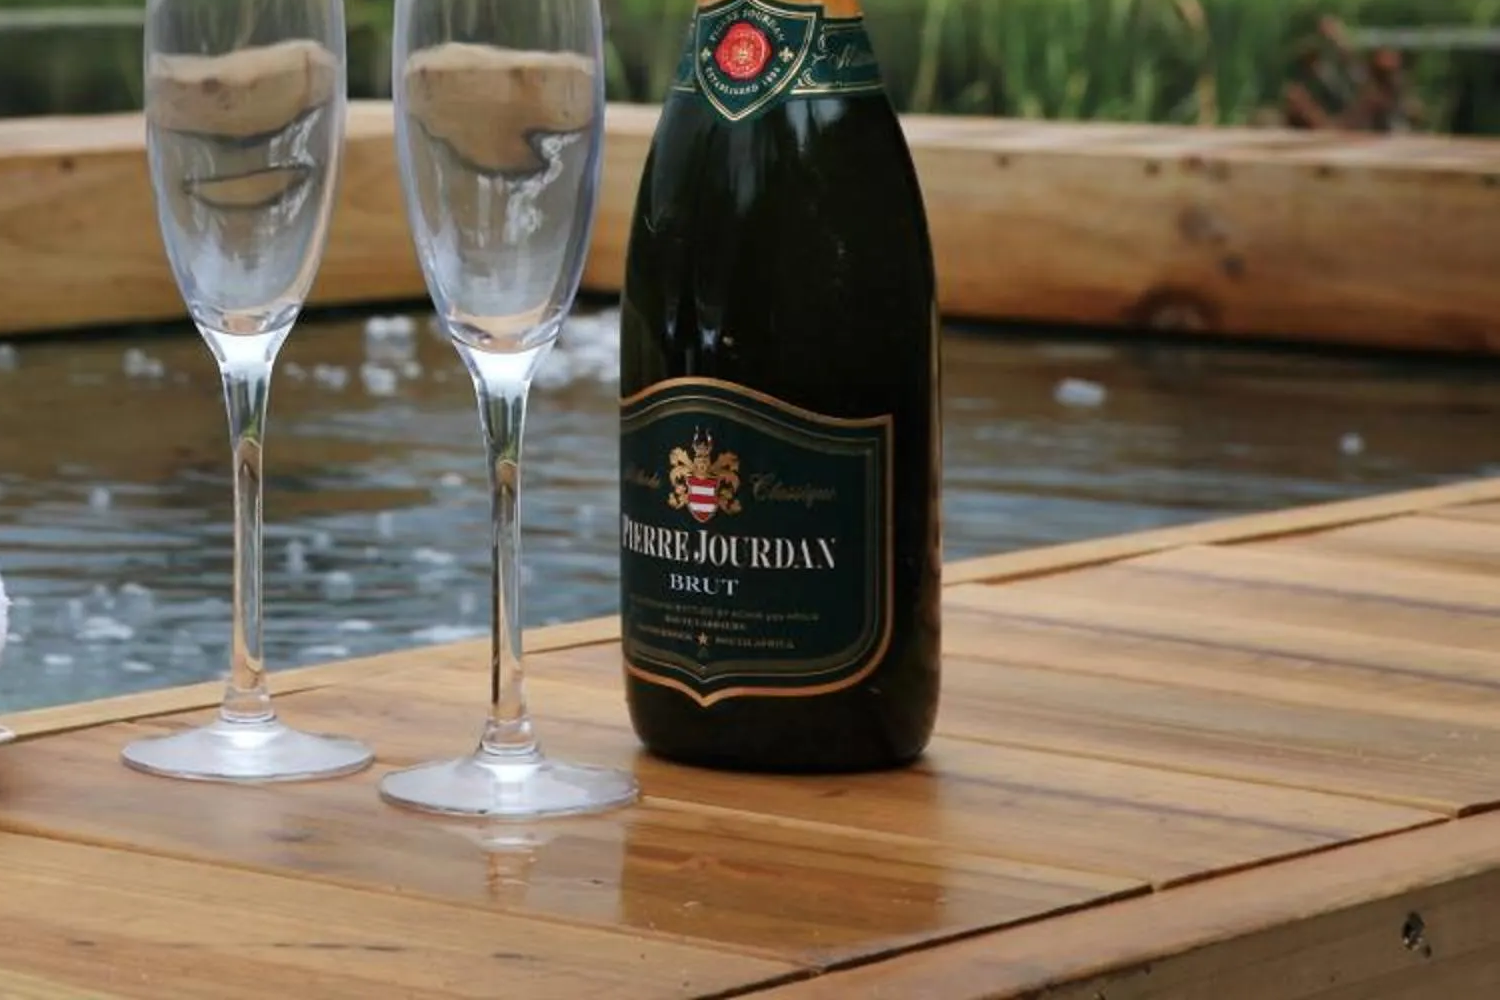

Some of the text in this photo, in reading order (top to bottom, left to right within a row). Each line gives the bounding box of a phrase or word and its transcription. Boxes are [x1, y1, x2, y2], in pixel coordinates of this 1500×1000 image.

[621, 514, 837, 570] PIERRE JOURDAN
[670, 573, 740, 596] BRUT
